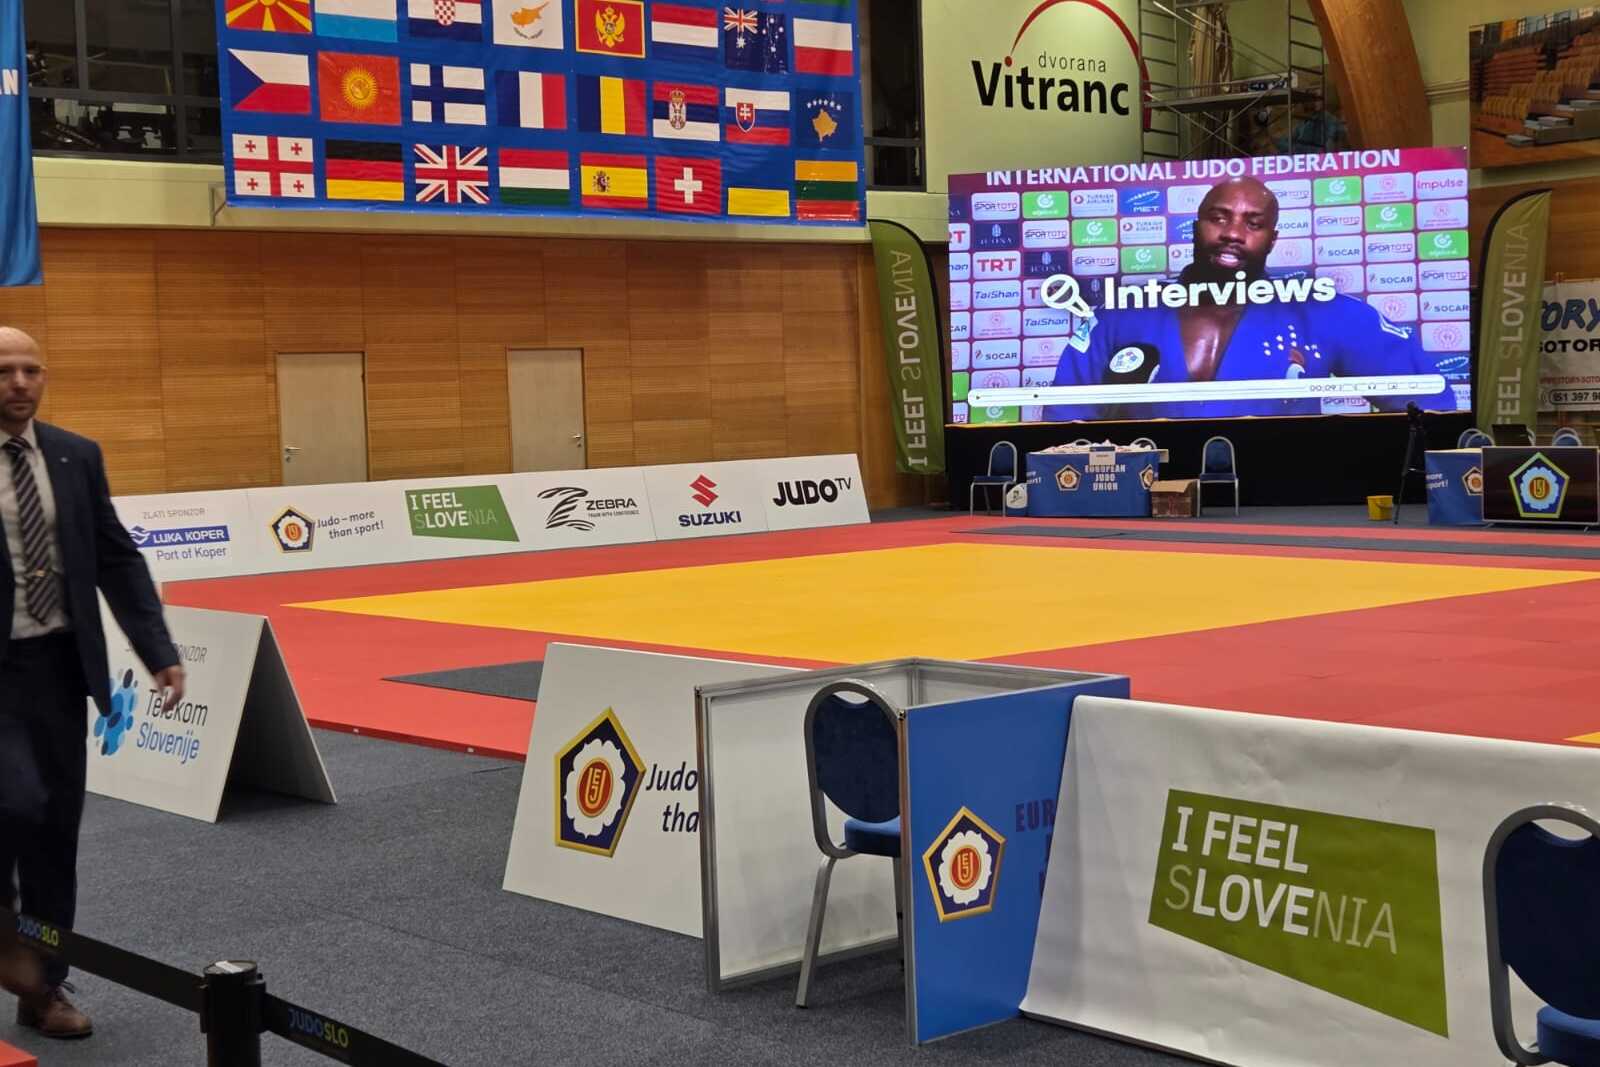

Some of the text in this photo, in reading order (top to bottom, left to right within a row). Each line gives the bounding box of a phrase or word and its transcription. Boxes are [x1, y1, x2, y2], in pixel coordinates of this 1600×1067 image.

[1038, 51, 1106, 73] dvorana
[971, 56, 1129, 116] Vitranc
[986, 149, 1400, 186] INTERNATIONAL JUDO FEDERATION
[1417, 177, 1464, 190] impulse
[1328, 248, 1360, 257] SOCAR
[976, 258, 1017, 272] TRT
[1380, 276, 1413, 284] SOCAR
[975, 290, 1019, 300] TaiShan
[1104, 271, 1337, 310] Interviews
[1500, 223, 1529, 359] SLOVENIA
[1434, 305, 1469, 313] SOCAR
[1541, 298, 1600, 332] ORY
[1025, 318, 1068, 327] TaiShan
[985, 352, 1017, 361] SOCAR
[1093, 482, 1118, 491] UNION
[1095, 473, 1116, 482] JUDO
[409, 491, 463, 511] I FEEL
[585, 498, 638, 511] ZEBRA
[143, 510, 166, 520] ZLATI
[317, 516, 340, 528] Judo
[350, 510, 375, 522] more
[414, 508, 497, 530] SLOVENIA
[678, 510, 742, 527] SUZUKI
[152, 529, 225, 544] LUKA KOPER
[329, 520, 384, 539] than sport!
[156, 546, 226, 561] Port of Koper
[136, 722, 200, 765] Slovenije
[645, 761, 698, 791] Judo
[662, 802, 700, 833] tha
[1015, 798, 1057, 833] EUR
[1172, 806, 1308, 874] I FEEL
[1165, 864, 1397, 955] SLOVENIA
[288, 1008, 349, 1048] JUDOSLO
